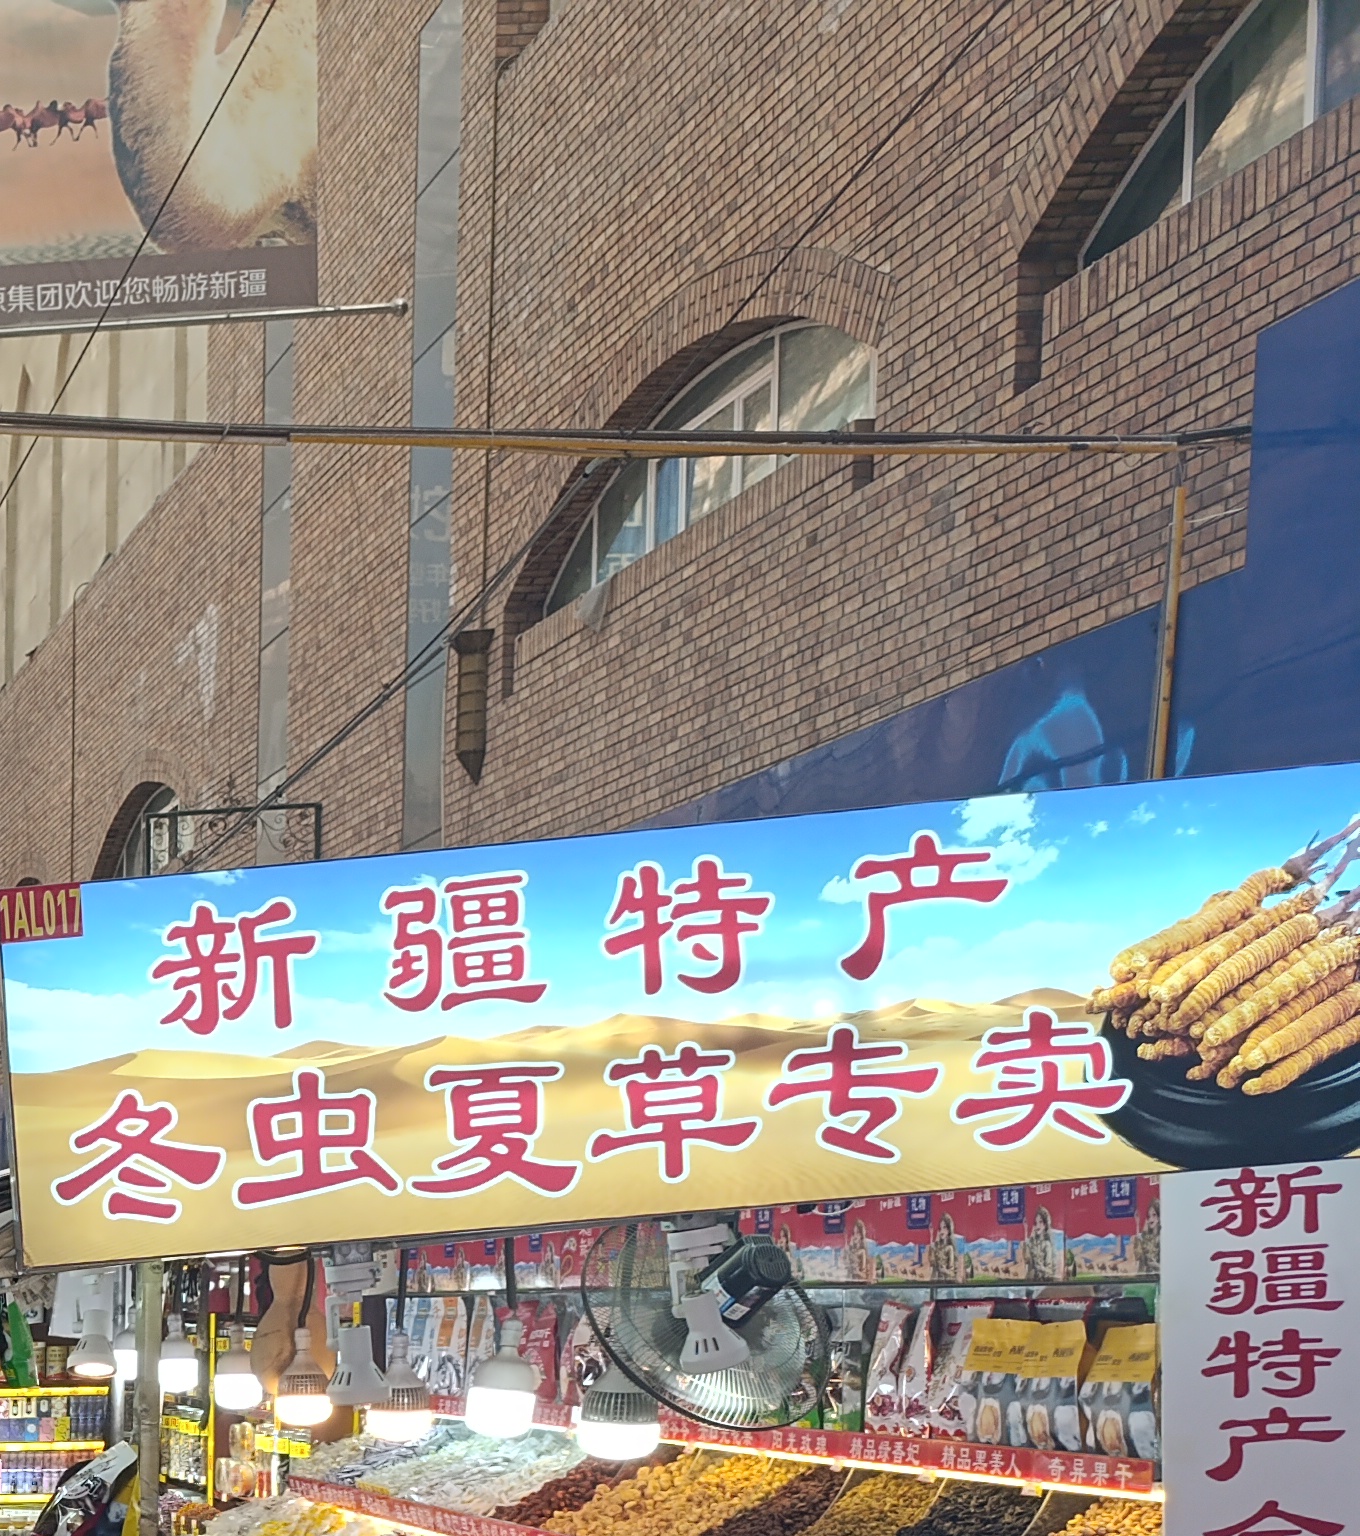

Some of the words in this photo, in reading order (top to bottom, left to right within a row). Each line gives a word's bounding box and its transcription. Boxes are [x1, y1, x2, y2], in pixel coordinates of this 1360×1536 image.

[0, 889, 81, 940] 1AL017
[156, 834, 1009, 1033] 新疆特产
[56, 1012, 1131, 1221] 冬虫夏草专卖
[849, 1437, 921, 1466] 精品绿香妃
[941, 1445, 1021, 1477] 精品黑美人
[1048, 1457, 1134, 1489] 奇异果干
